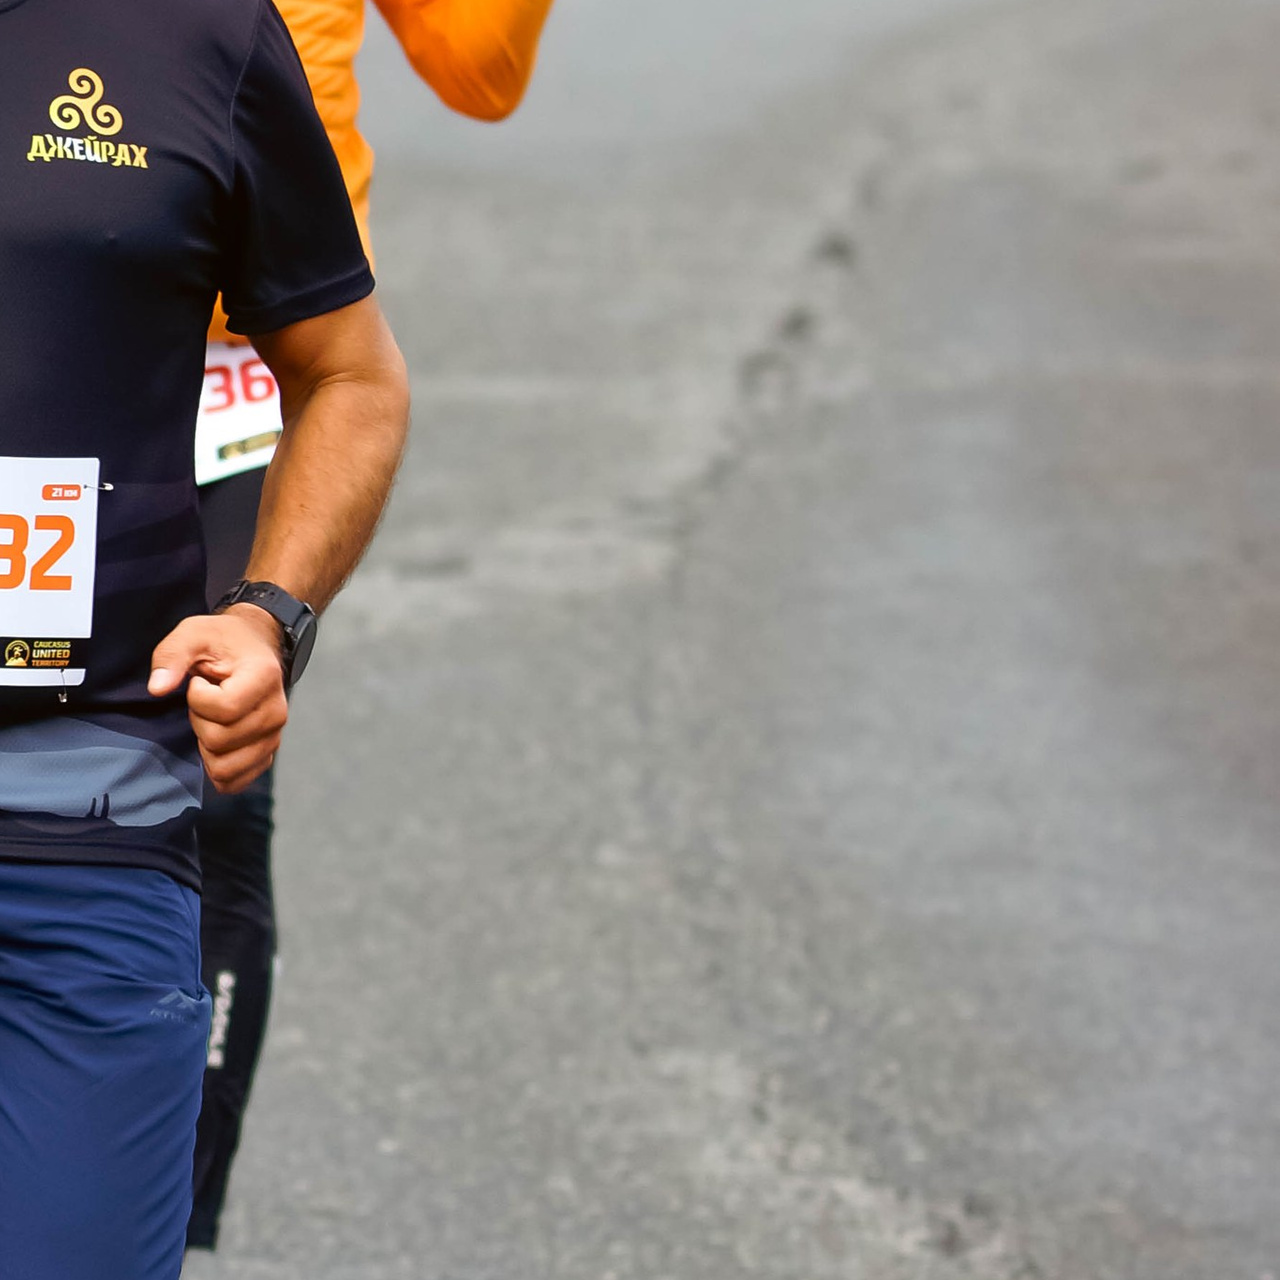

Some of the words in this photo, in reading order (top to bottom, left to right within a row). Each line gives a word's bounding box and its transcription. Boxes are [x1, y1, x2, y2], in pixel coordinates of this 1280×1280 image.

[26, 134, 149, 168] ДЖЕЙРАХ
[33, 641, 71, 649] CAUCASUS
[32, 649, 71, 658] UNITED
